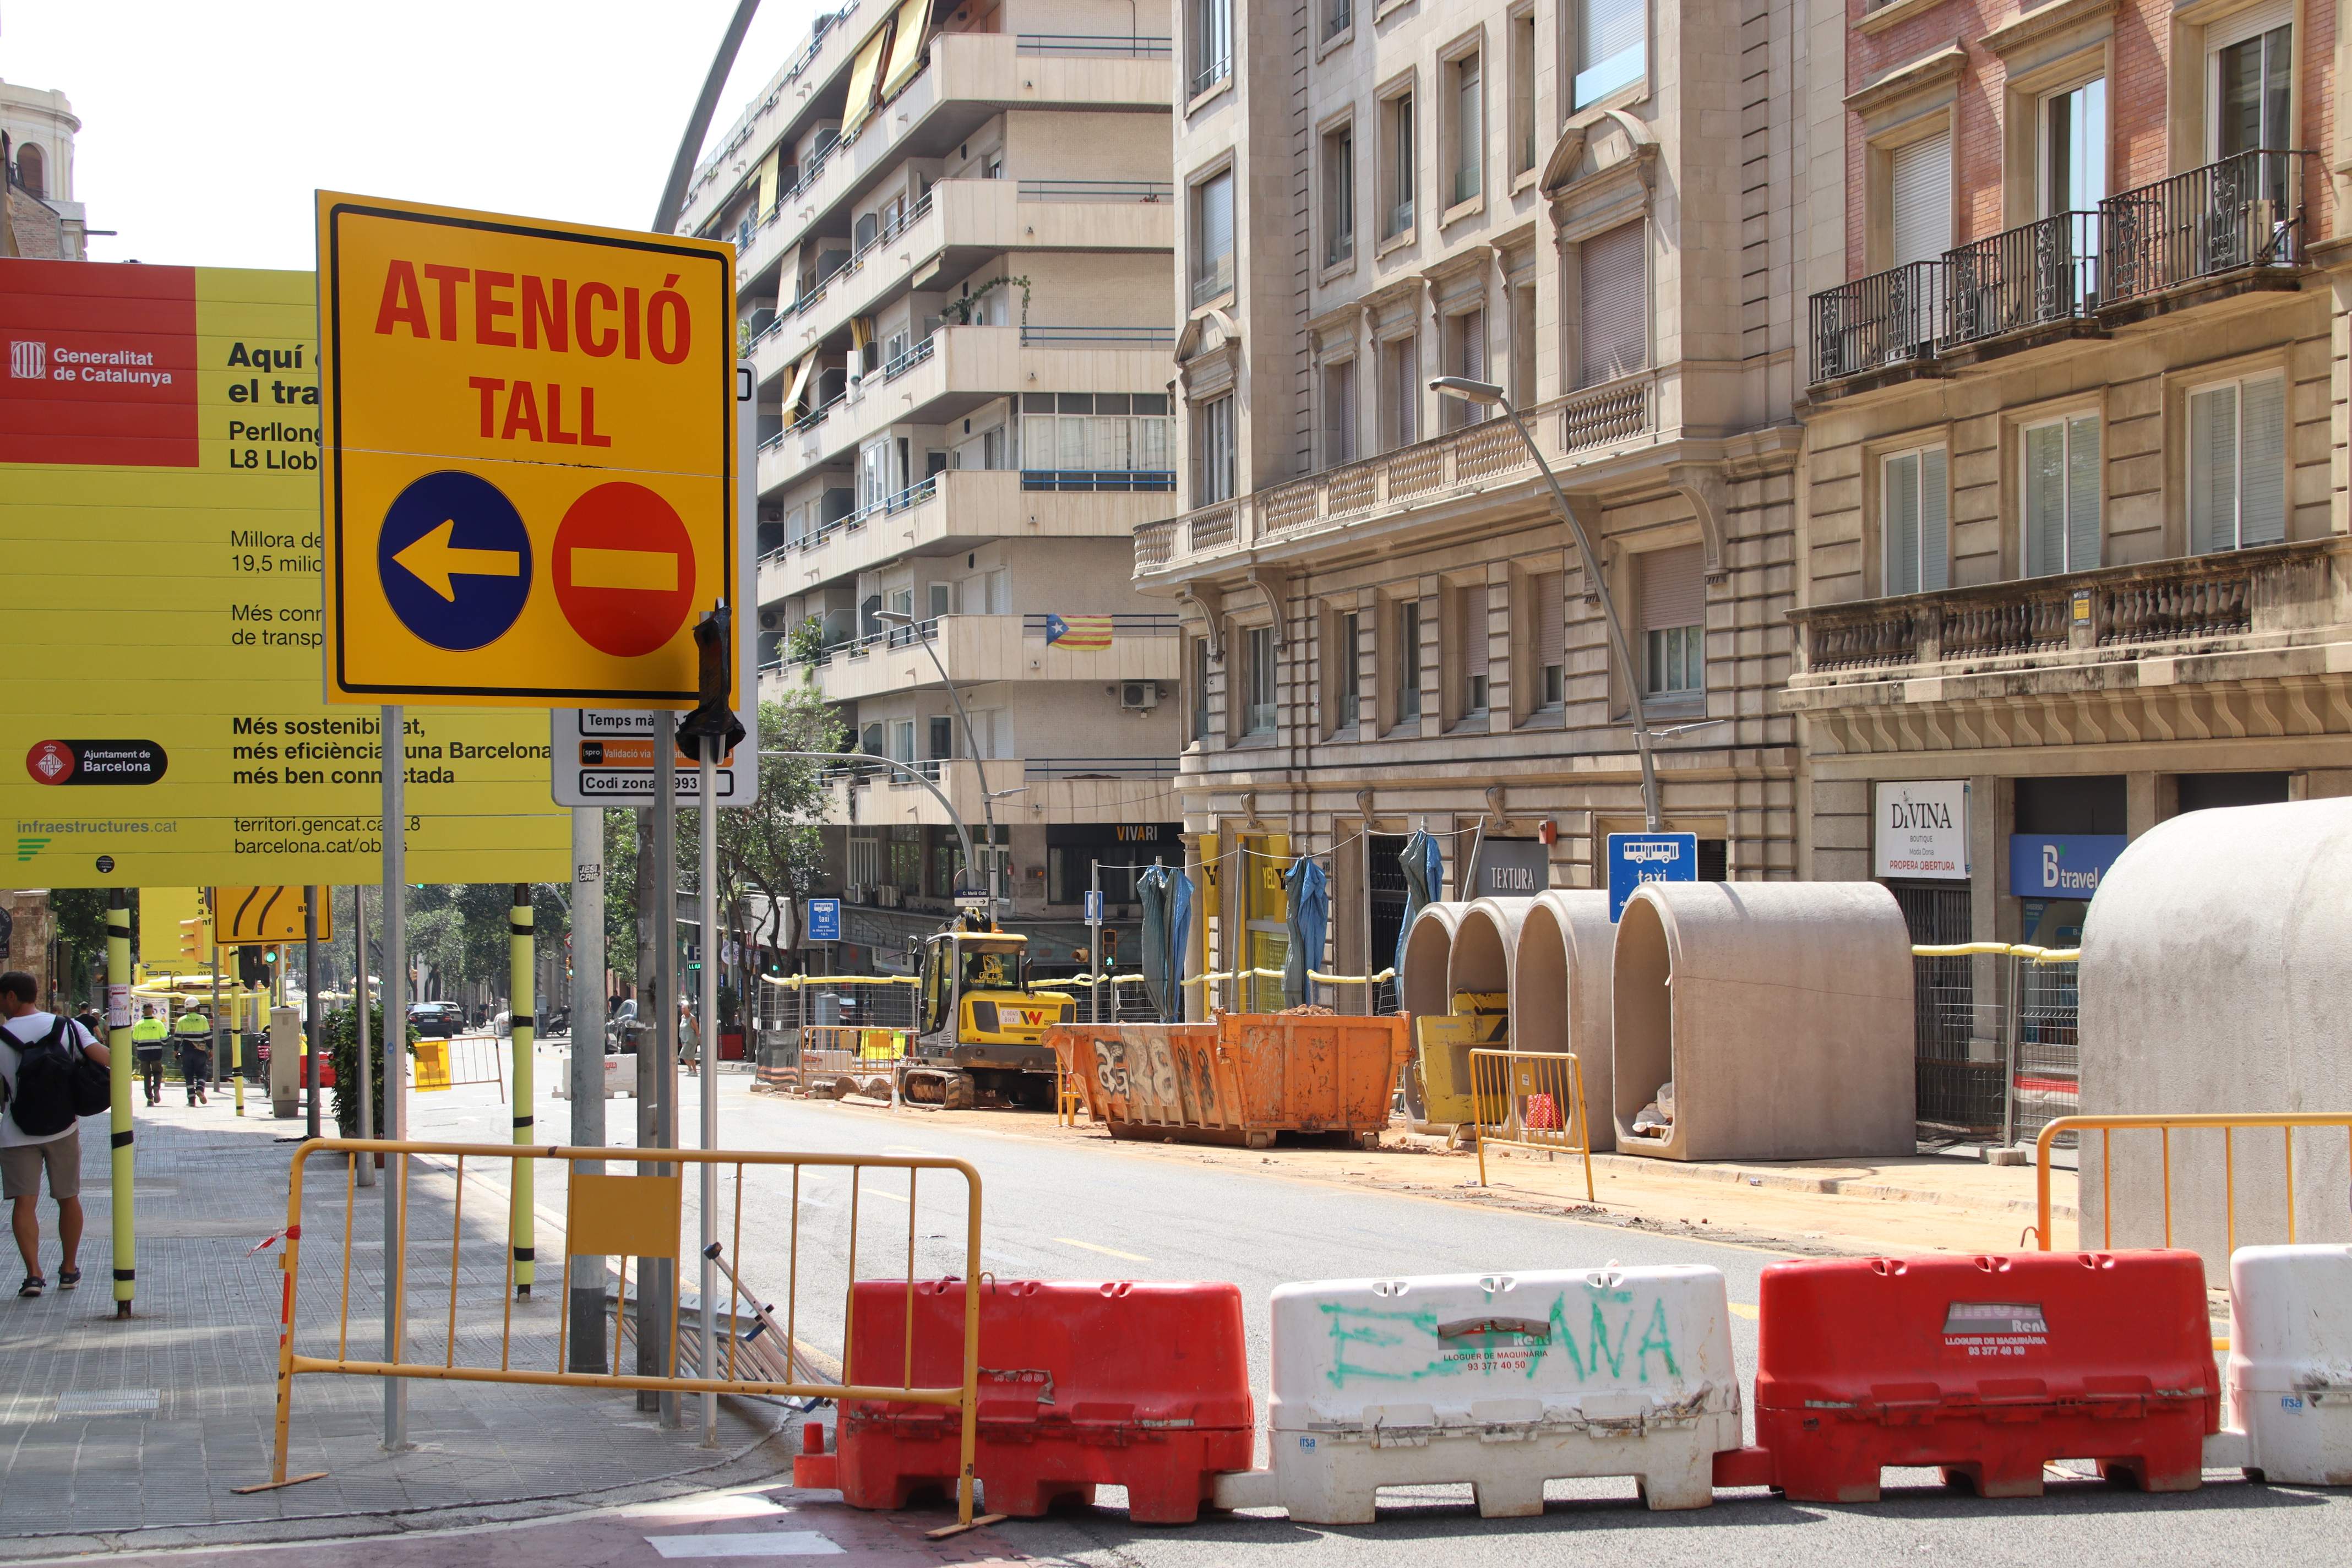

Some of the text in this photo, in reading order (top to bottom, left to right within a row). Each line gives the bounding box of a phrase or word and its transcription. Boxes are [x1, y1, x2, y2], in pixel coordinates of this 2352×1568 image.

[374, 259, 691, 364] ATENCIÓ
[53, 347, 154, 366] Generalitat
[227, 342, 304, 373] Aquí
[53, 366, 172, 388] de Catalunya
[228, 379, 259, 403] el
[469, 376, 611, 448] TALL
[230, 449, 318, 471] L8 Llob
[231, 530, 295, 548] Millora
[232, 555, 273, 574] 19,5
[232, 604, 273, 621] Més
[232, 628, 256, 645] de
[233, 717, 278, 734] Més
[588, 714, 631, 729] Temps
[84, 750, 150, 760] Ajuntament de
[233, 742, 278, 759] més
[405, 746, 442, 759] una
[449, 742, 551, 759] Barcelona
[604, 749, 638, 758] Validació
[640, 749, 651, 758] via
[84, 761, 151, 772] Barcelona
[233, 767, 278, 784] més
[285, 767, 324, 784] ben
[586, 777, 618, 789] Codi
[623, 779, 655, 789] zona
[17, 820, 177, 834] infraestructures.cat
[1117, 826, 1157, 841] VIVARI
[1909, 835, 1933, 843] BOUTIQUE
[1890, 860, 1956, 871] PROPERA OBERTURA
[1491, 867, 1534, 890] TEXTURA
[1638, 869, 1667, 883] taxi
[2061, 867, 2098, 889] travel
[819, 914, 829, 923] taxi
[2012, 1319, 2047, 1333] Rent
[1513, 1333, 1550, 1346] Rent
[1945, 1335, 2047, 1346] LLOGUER DE MAQUINÀRIA
[1444, 1352, 1482, 1362] LLOGUER
[1497, 1349, 1548, 1359] MAQUINÀRIA
[1968, 1347, 1980, 1355] 93
[1982, 1346, 1998, 1355] 377
[1468, 1360, 1526, 1371] 93 377 40 50
